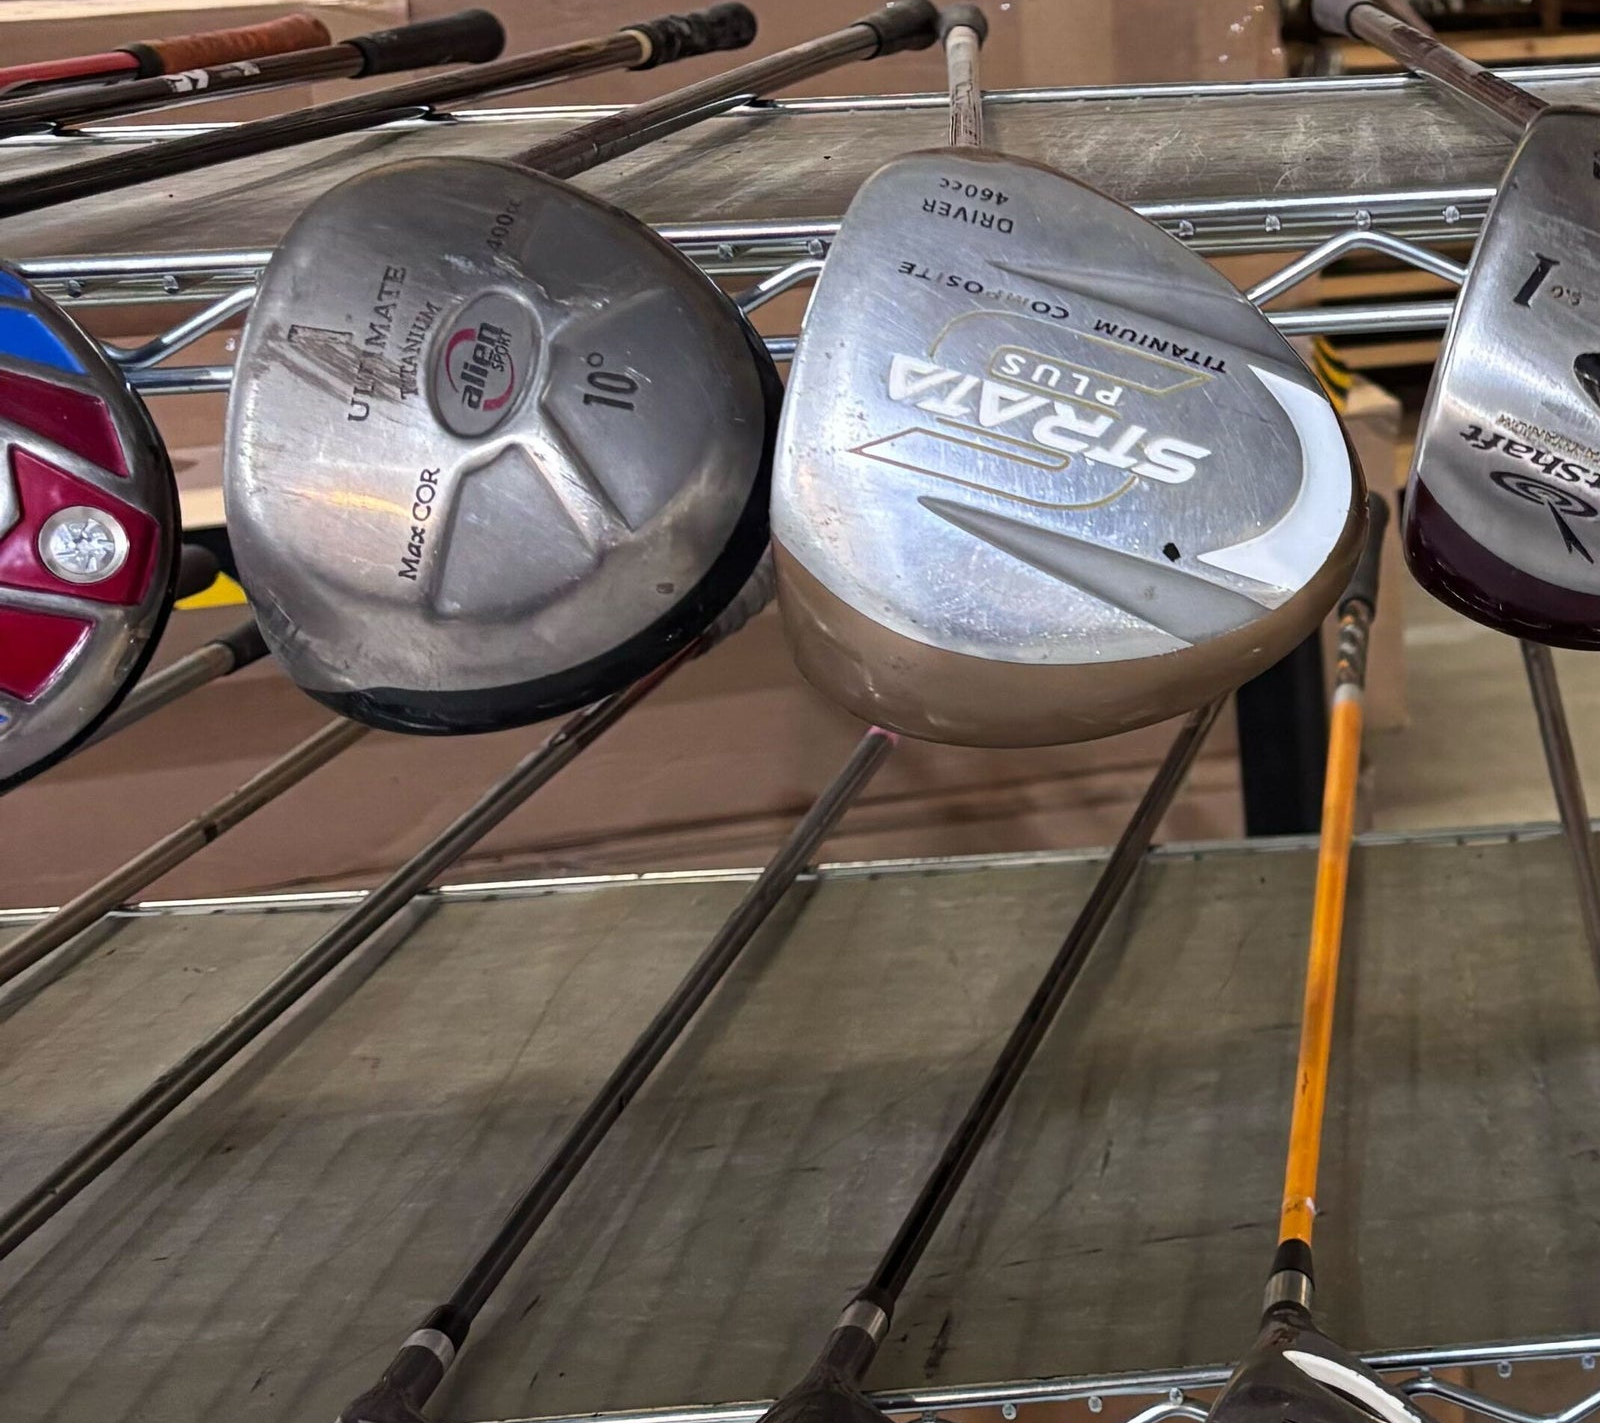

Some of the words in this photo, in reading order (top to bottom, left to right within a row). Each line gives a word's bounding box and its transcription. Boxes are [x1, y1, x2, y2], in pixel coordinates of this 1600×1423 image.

[921, 197, 1015, 235] DRIVER
[938, 177, 1010, 207] 460cc
[486, 197, 523, 252] 400cc
[346, 265, 408, 423] ULTIMATE
[399, 301, 443, 400] TITANIUM
[460, 321, 502, 412] alien
[489, 329, 514, 372] SPORT
[1093, 316, 1229, 375] TITANIUM
[1000, 352, 1124, 406] PLUS
[887, 353, 1213, 485] STRATA
